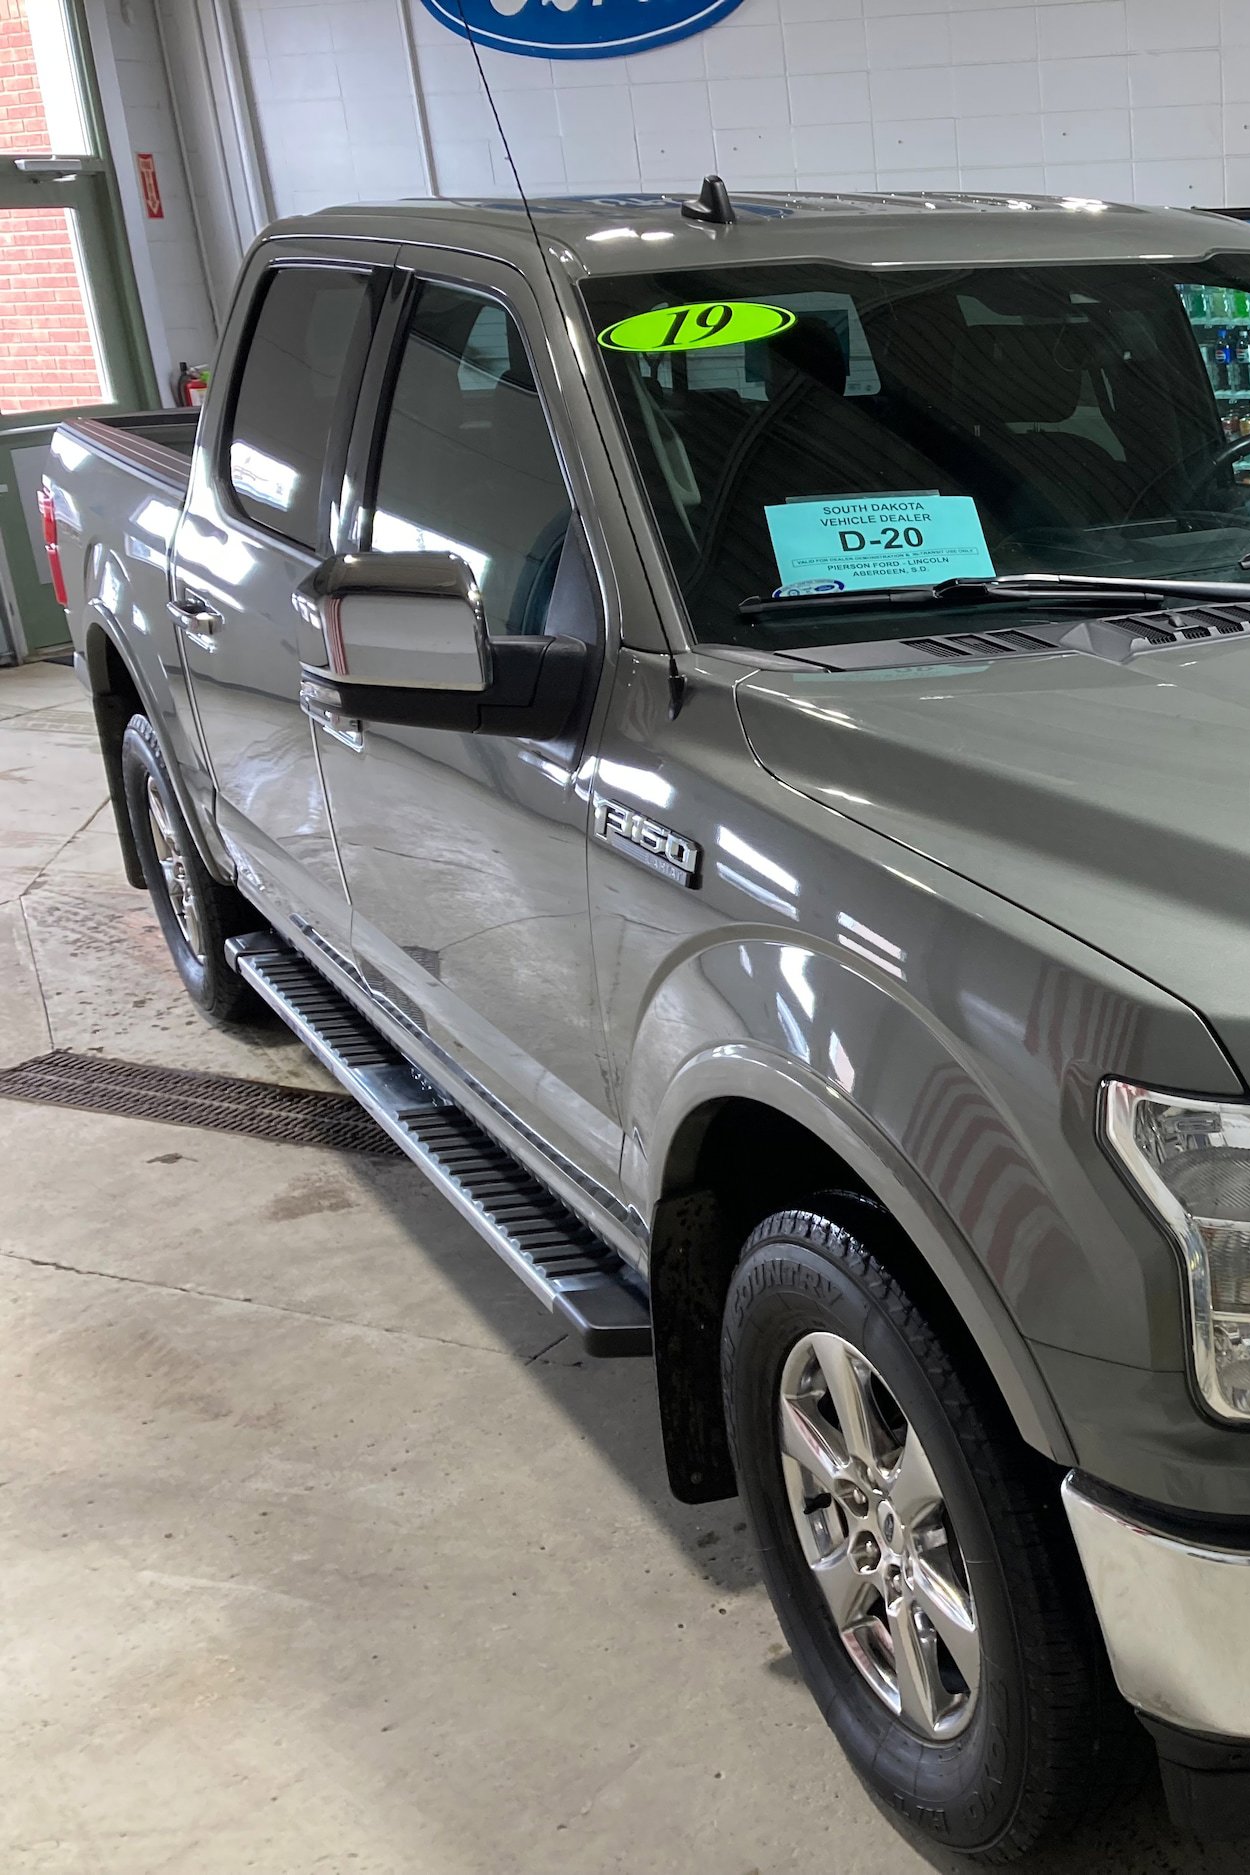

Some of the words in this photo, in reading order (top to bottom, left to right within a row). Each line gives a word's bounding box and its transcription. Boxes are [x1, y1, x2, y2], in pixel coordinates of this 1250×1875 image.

[652, 304, 733, 348] 19
[823, 504, 868, 515] SOUTH
[871, 502, 924, 513] DAKOTA
[820, 515, 877, 527] VEHICLE
[880, 513, 932, 523] DEALER
[838, 527, 924, 552] D-20
[827, 562, 871, 571] PIERSON
[908, 557, 950, 566] LINCOLN
[852, 568, 909, 577] ABERDEEN,
[734, 1259, 842, 1329] COUNTRY
